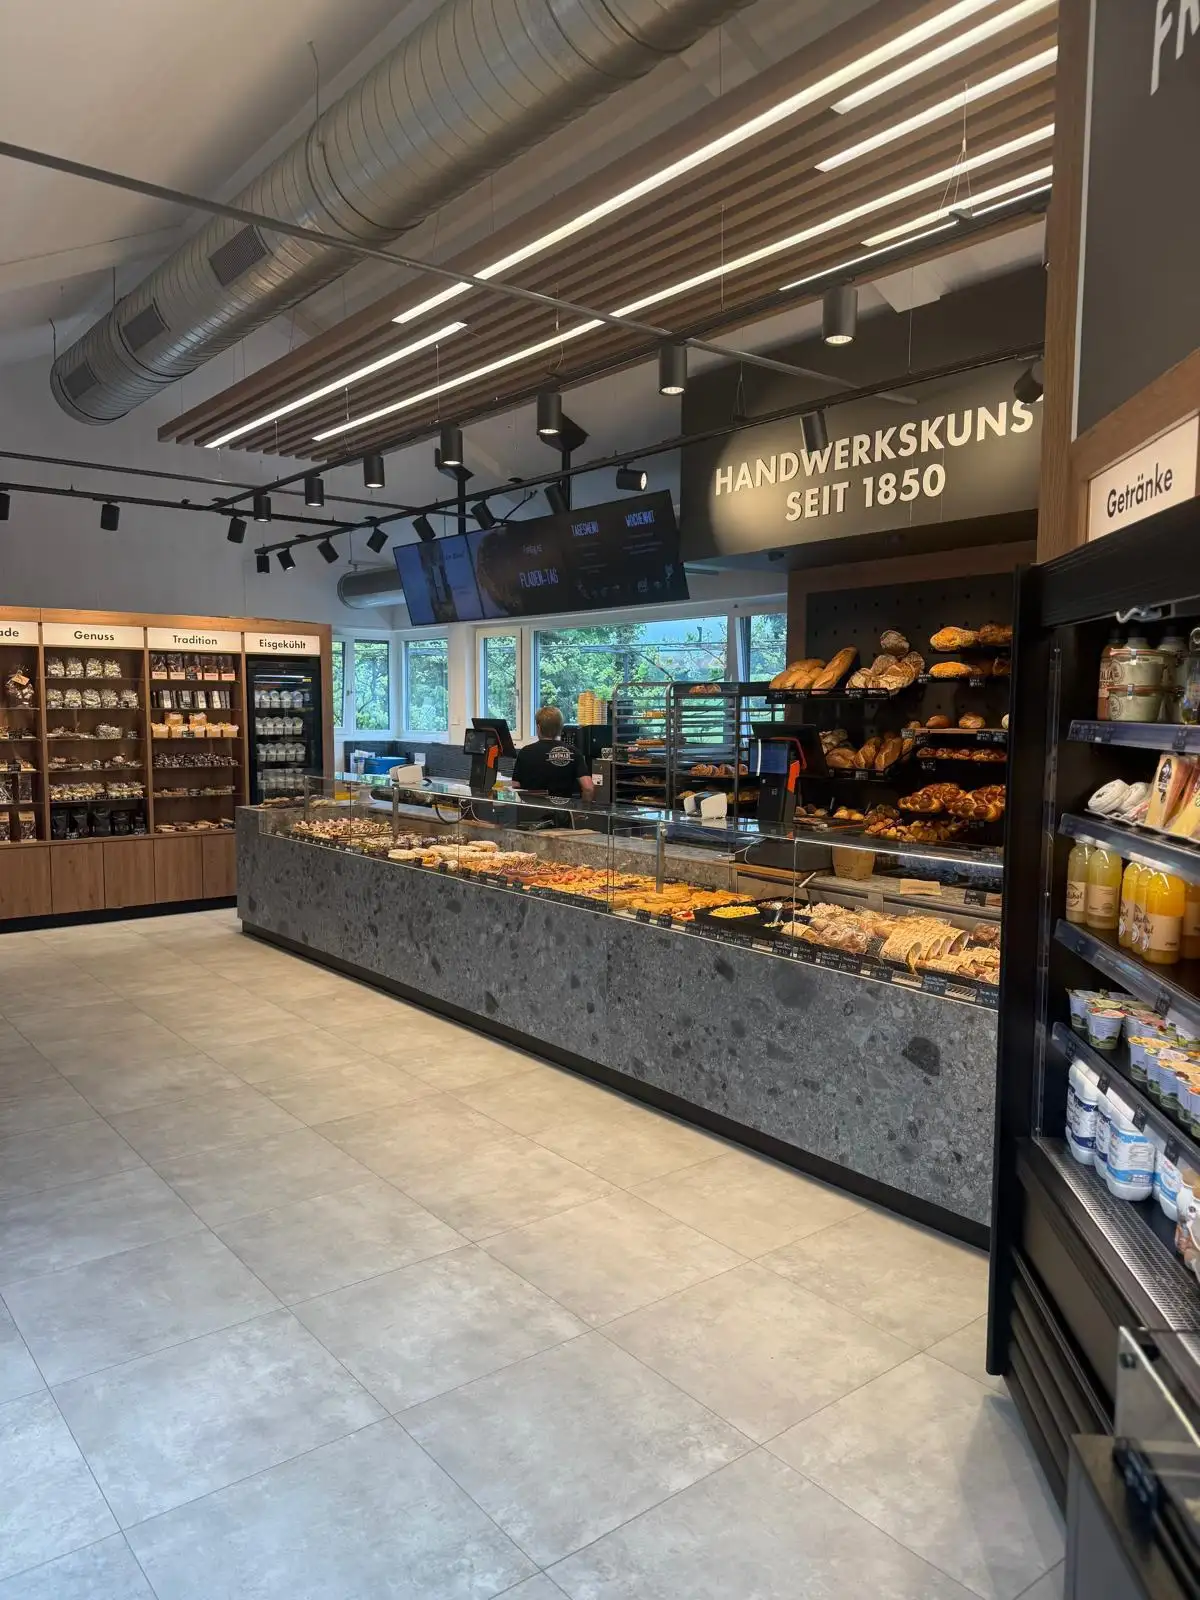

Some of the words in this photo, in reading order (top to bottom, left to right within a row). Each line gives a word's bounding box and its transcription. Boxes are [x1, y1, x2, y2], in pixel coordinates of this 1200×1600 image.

[714, 393, 1043, 496] HANDWERKSKUNS
[785, 482, 849, 522] SEIT
[863, 463, 946, 508] 1850
[1106, 462, 1173, 518] Getränke
[73, 630, 115, 641] Genuss
[172, 634, 218, 646] Tradition
[259, 639, 306, 650] Eisgekühlt
